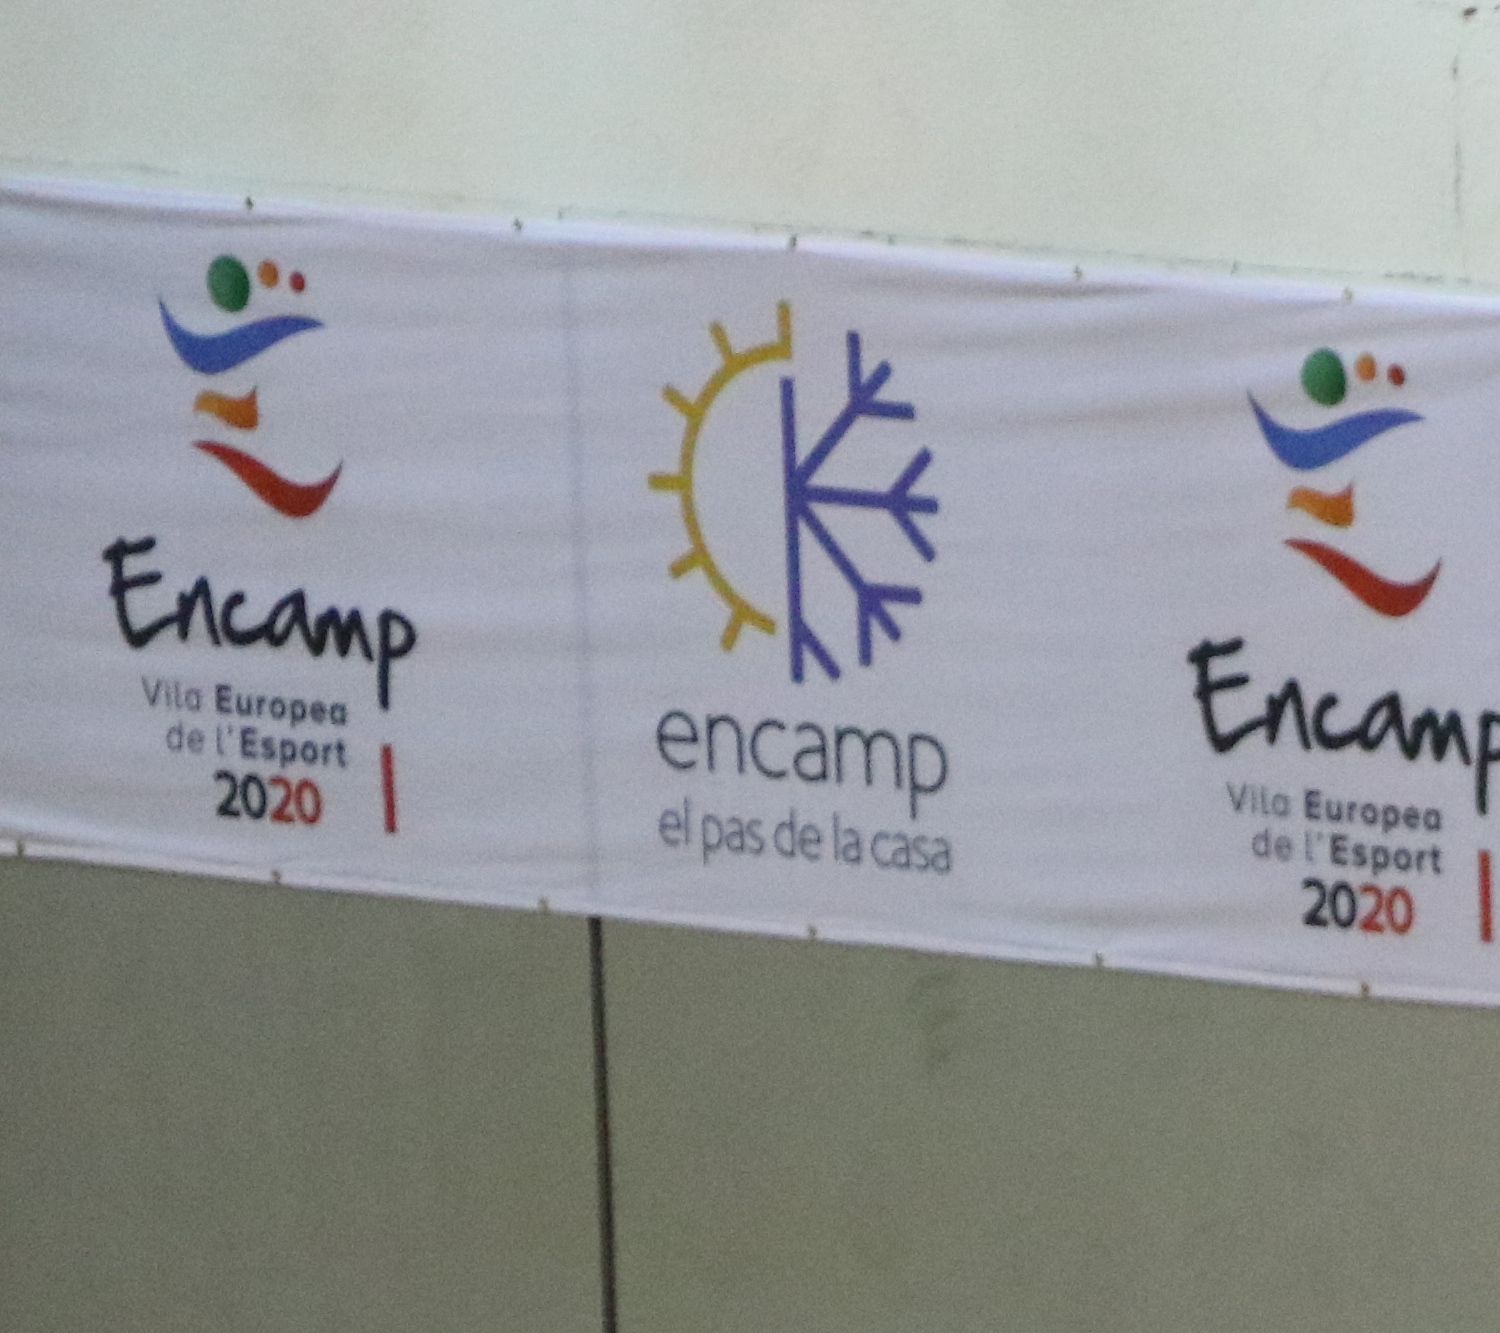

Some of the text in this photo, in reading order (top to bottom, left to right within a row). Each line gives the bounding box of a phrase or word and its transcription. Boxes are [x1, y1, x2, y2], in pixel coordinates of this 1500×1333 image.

[102, 536, 417, 712] Encamp
[142, 676, 347, 727] Vila Europea
[166, 721, 347, 769] de l'Esport
[656, 709, 949, 821] encamp
[213, 769, 323, 825] 2020
[1226, 781, 1442, 833] Vila Europea
[659, 797, 952, 874] el pas de la casa
[1252, 829, 1442, 875] de l'Esport
[1302, 877, 1416, 935] 2020
